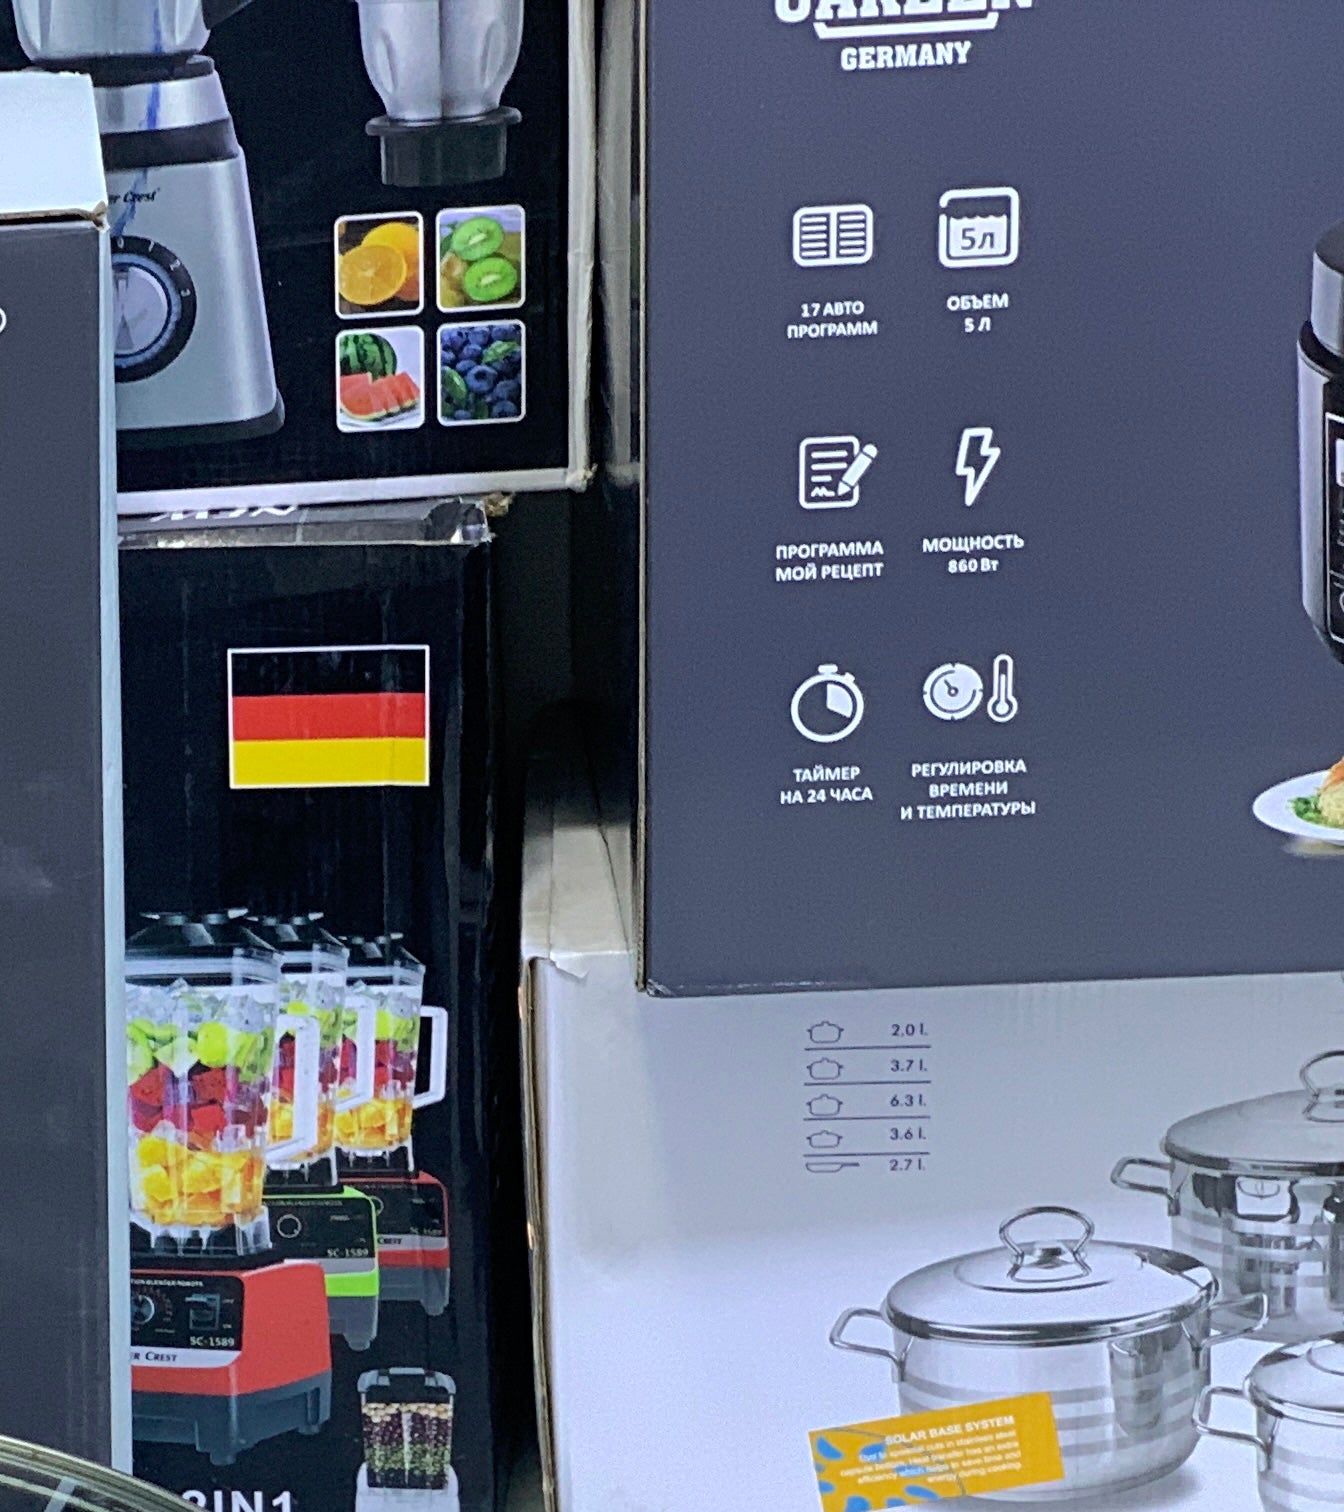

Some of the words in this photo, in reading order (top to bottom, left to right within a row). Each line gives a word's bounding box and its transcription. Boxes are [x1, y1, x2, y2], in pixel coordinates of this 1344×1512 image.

[841, 40, 971, 71] GERMANY
[960, 227, 995, 250] 5л
[801, 303, 820, 318] 17
[823, 301, 865, 317] АВТО
[947, 293, 1009, 311] ОБЪЕМ
[787, 320, 878, 339] ПРОГРАММ
[964, 317, 975, 333] 5
[776, 541, 884, 560] ПРОГРАММА
[923, 534, 1024, 553] МОЩНОСТЬ
[776, 563, 816, 582] МОЙ
[821, 562, 883, 580] РЕЦЕПТ
[947, 559, 978, 573] 860
[981, 558, 999, 573] Вт
[793, 764, 860, 782] ТАЙМЕР
[912, 759, 1027, 777] РЕГУЛИРОВКА
[780, 791, 803, 804] НА
[807, 789, 826, 803] 24
[829, 786, 873, 801] ЧАСА
[929, 781, 1008, 798] ВРЕМЕНИ
[900, 806, 912, 820] И
[917, 801, 1036, 819] ТЕМПЕРАТУРЫ
[891, 1023, 915, 1036] 2.0
[890, 1059, 914, 1072] 3.7
[890, 1094, 914, 1107] 6.3
[890, 1127, 913, 1140] 3.6
[889, 1158, 912, 1171] 2.7
[327, 1248, 369, 1259] SC-1589
[190, 1336, 235, 1347] SC-1589
[885, 1429, 926, 1445] SOLAR
[929, 1425, 961, 1439] BASE
[965, 1415, 1015, 1432] SYSTEM
